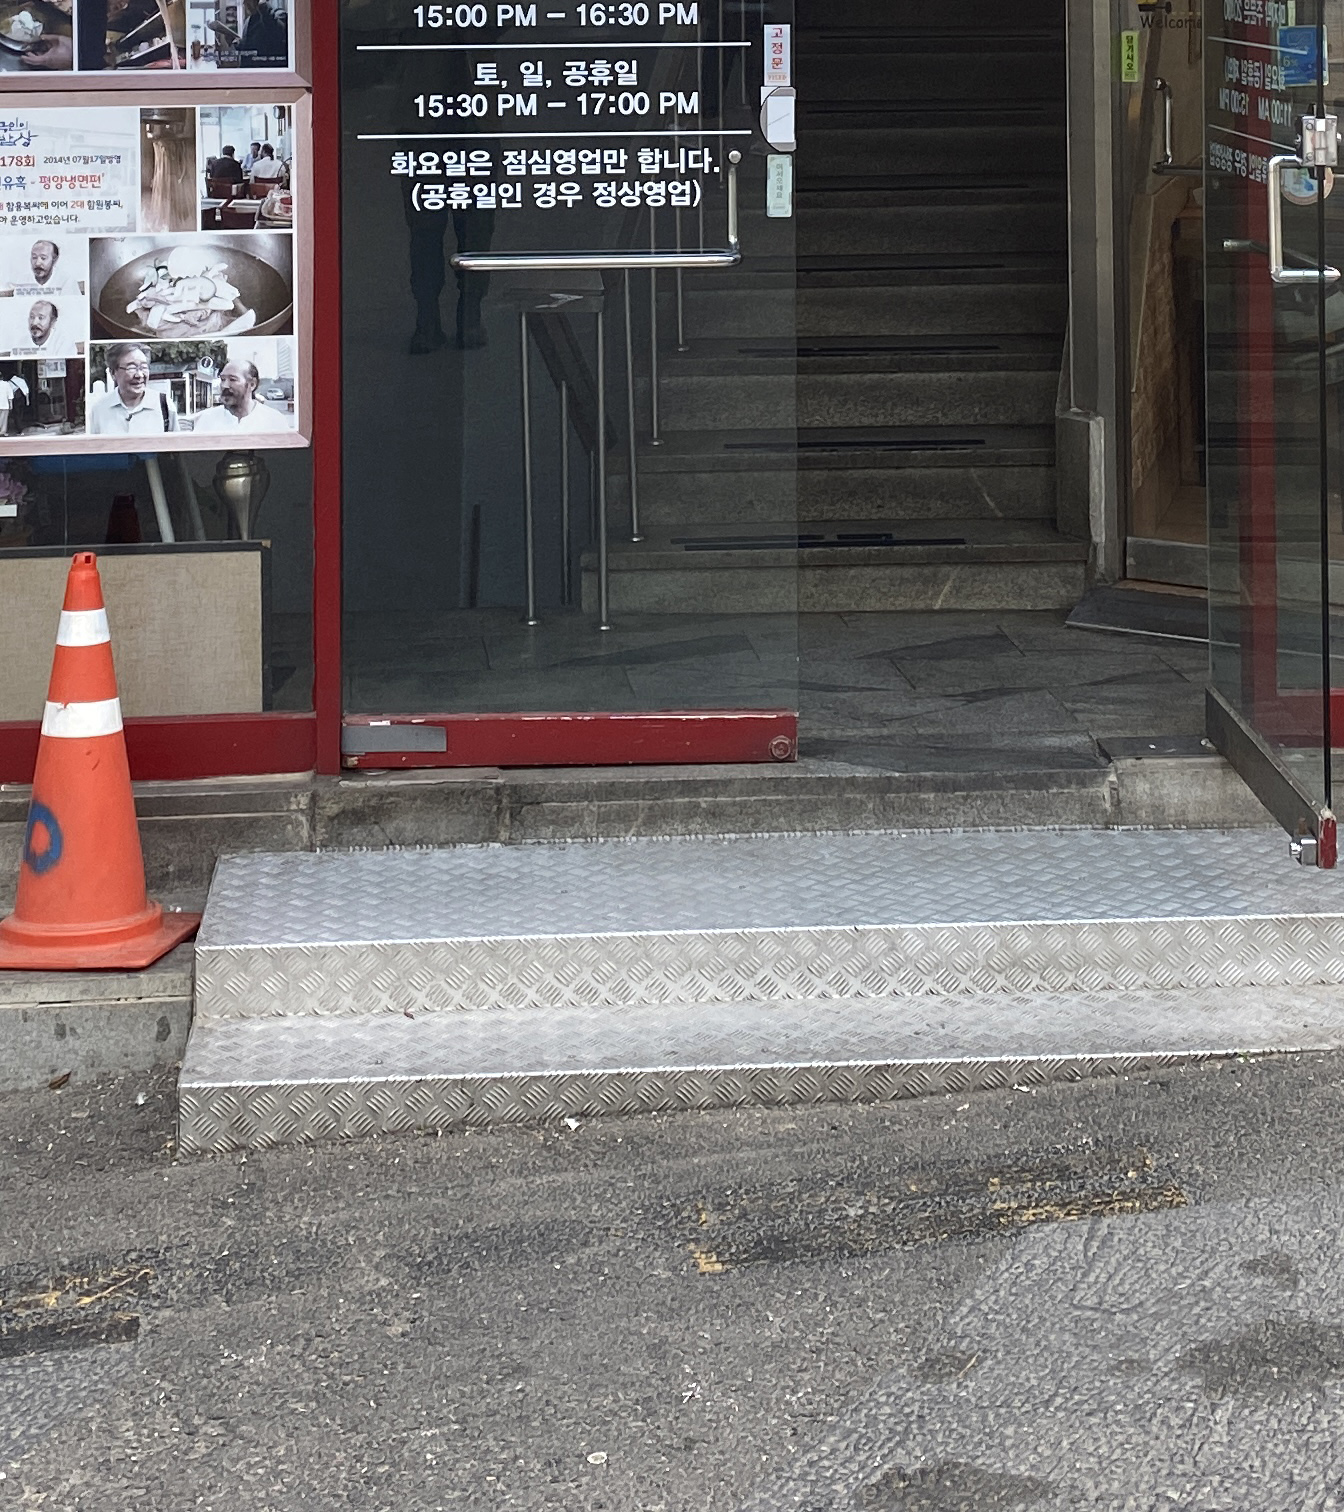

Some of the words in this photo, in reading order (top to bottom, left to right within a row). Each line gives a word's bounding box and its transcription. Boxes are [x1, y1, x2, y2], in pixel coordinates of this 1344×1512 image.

[413, 4, 488, 28] 15:00
[497, 4, 538, 27] PM
[576, 3, 649, 26] 16:30
[659, 3, 699, 26] PM
[1141, 14, 1202, 30] Welcome
[770, 26, 784, 71] 고정문
[473, 62, 508, 89] 토,
[520, 61, 552, 88] 일,
[562, 59, 639, 86] 공휴일
[413, 94, 488, 118] 15:30
[497, 93, 538, 116] PM
[576, 92, 650, 116] 17:00
[659, 92, 700, 115] PM
[43, 155, 71, 166] 2014년
[390, 150, 493, 177] 화요일은
[501, 149, 629, 176] 점심영업만
[637, 148, 721, 175] 합니다.
[51, 201, 68, 211] 이어
[70, 200, 85, 210] 2대
[411, 181, 524, 211] (공휴일인
[532, 180, 583, 209] 경우
[591, 179, 702, 208] 정상영업)
